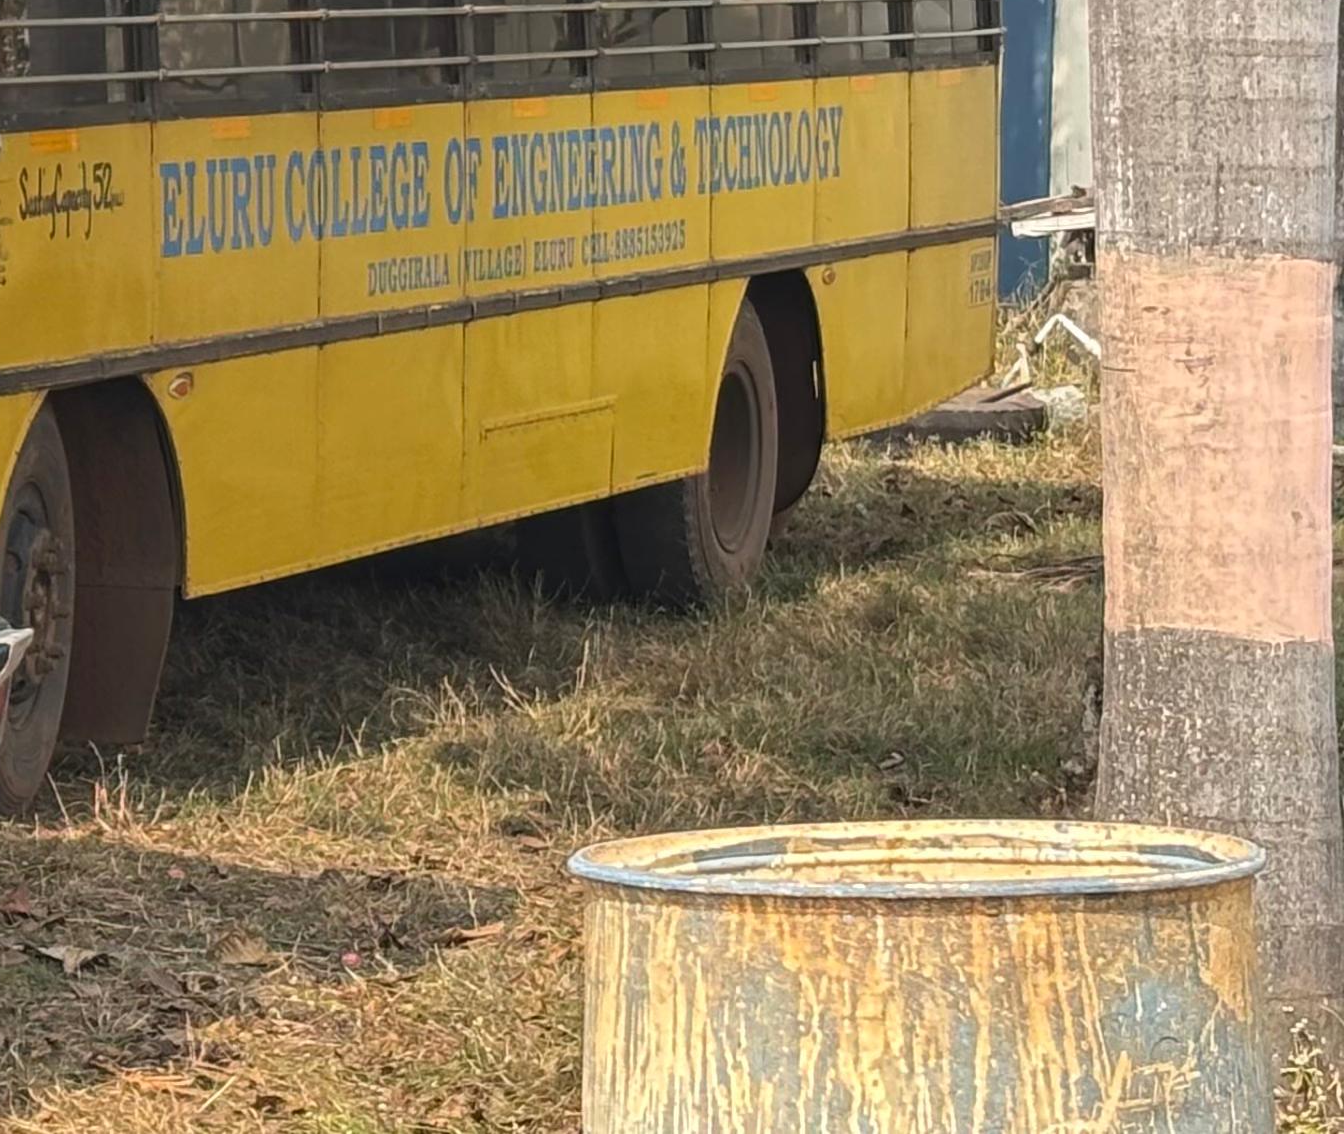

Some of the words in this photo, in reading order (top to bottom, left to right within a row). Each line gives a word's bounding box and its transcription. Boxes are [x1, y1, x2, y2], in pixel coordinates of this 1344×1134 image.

[160, 154, 277, 258] ELURU
[284, 141, 431, 242] COLLEGE
[444, 137, 482, 225] OF
[492, 121, 663, 220] ENGNEERING
[670, 120, 687, 199] &
[694, 106, 844, 195] TECHNOLOGY
[368, 253, 450, 297] DUGGIRALA
[533, 236, 576, 273] ELURU
